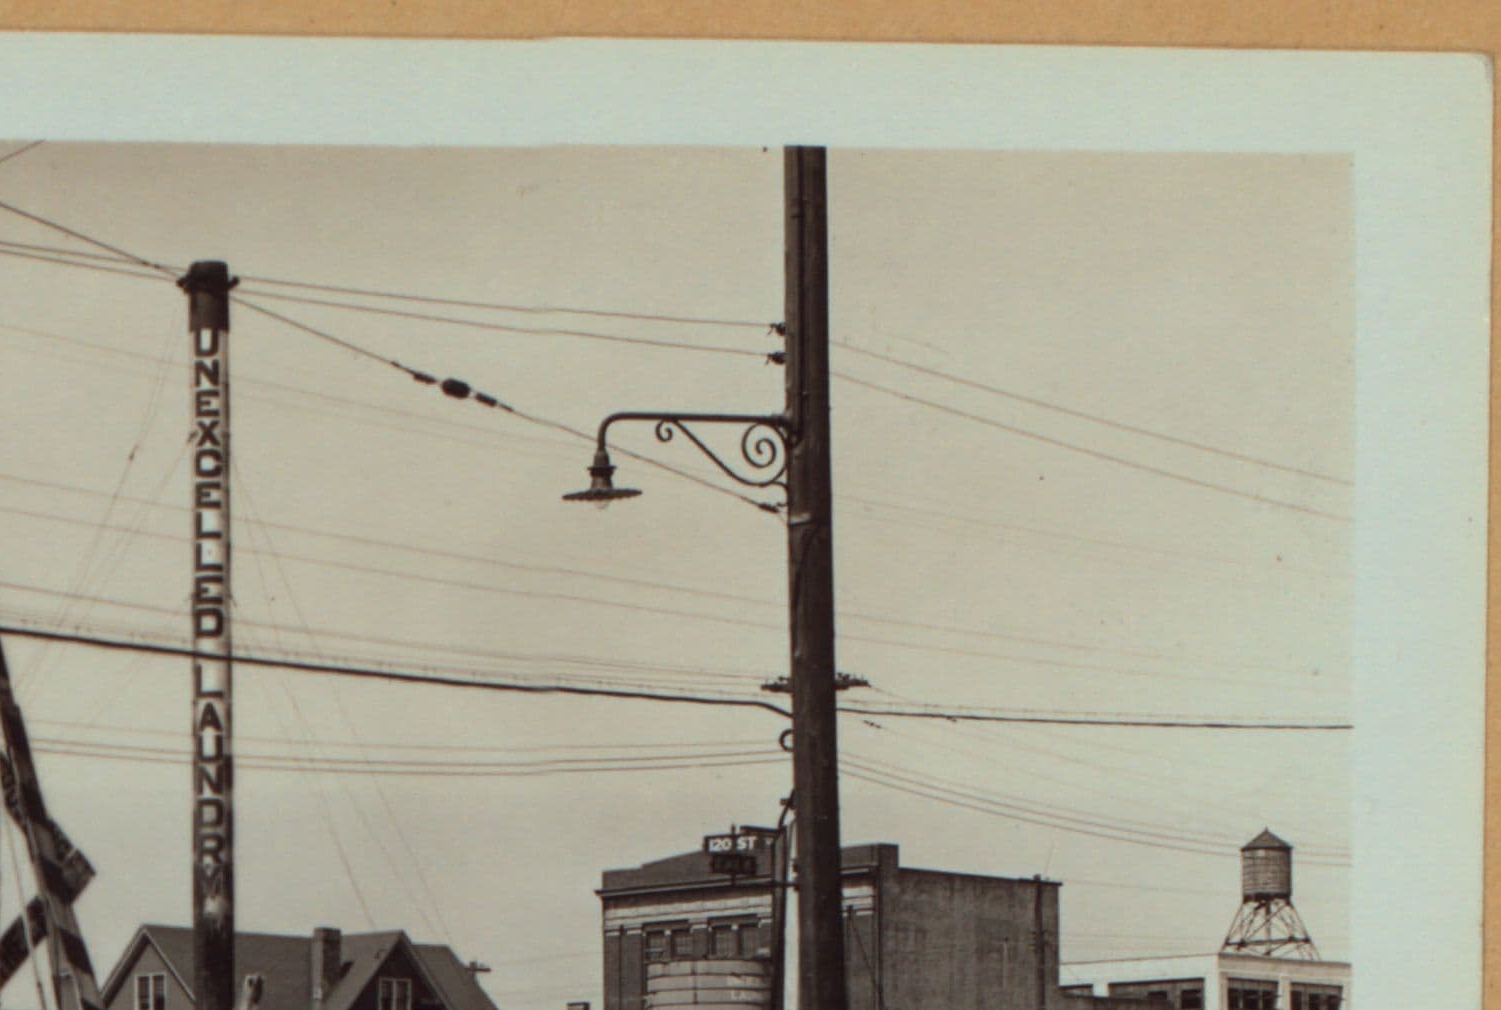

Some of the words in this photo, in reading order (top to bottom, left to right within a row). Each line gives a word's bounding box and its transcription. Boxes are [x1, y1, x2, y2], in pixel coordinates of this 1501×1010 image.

[194, 328, 224, 638] UNEXCELLED
[196, 660, 224, 898] LAUNDRY
[737, 836, 756, 851] ST
